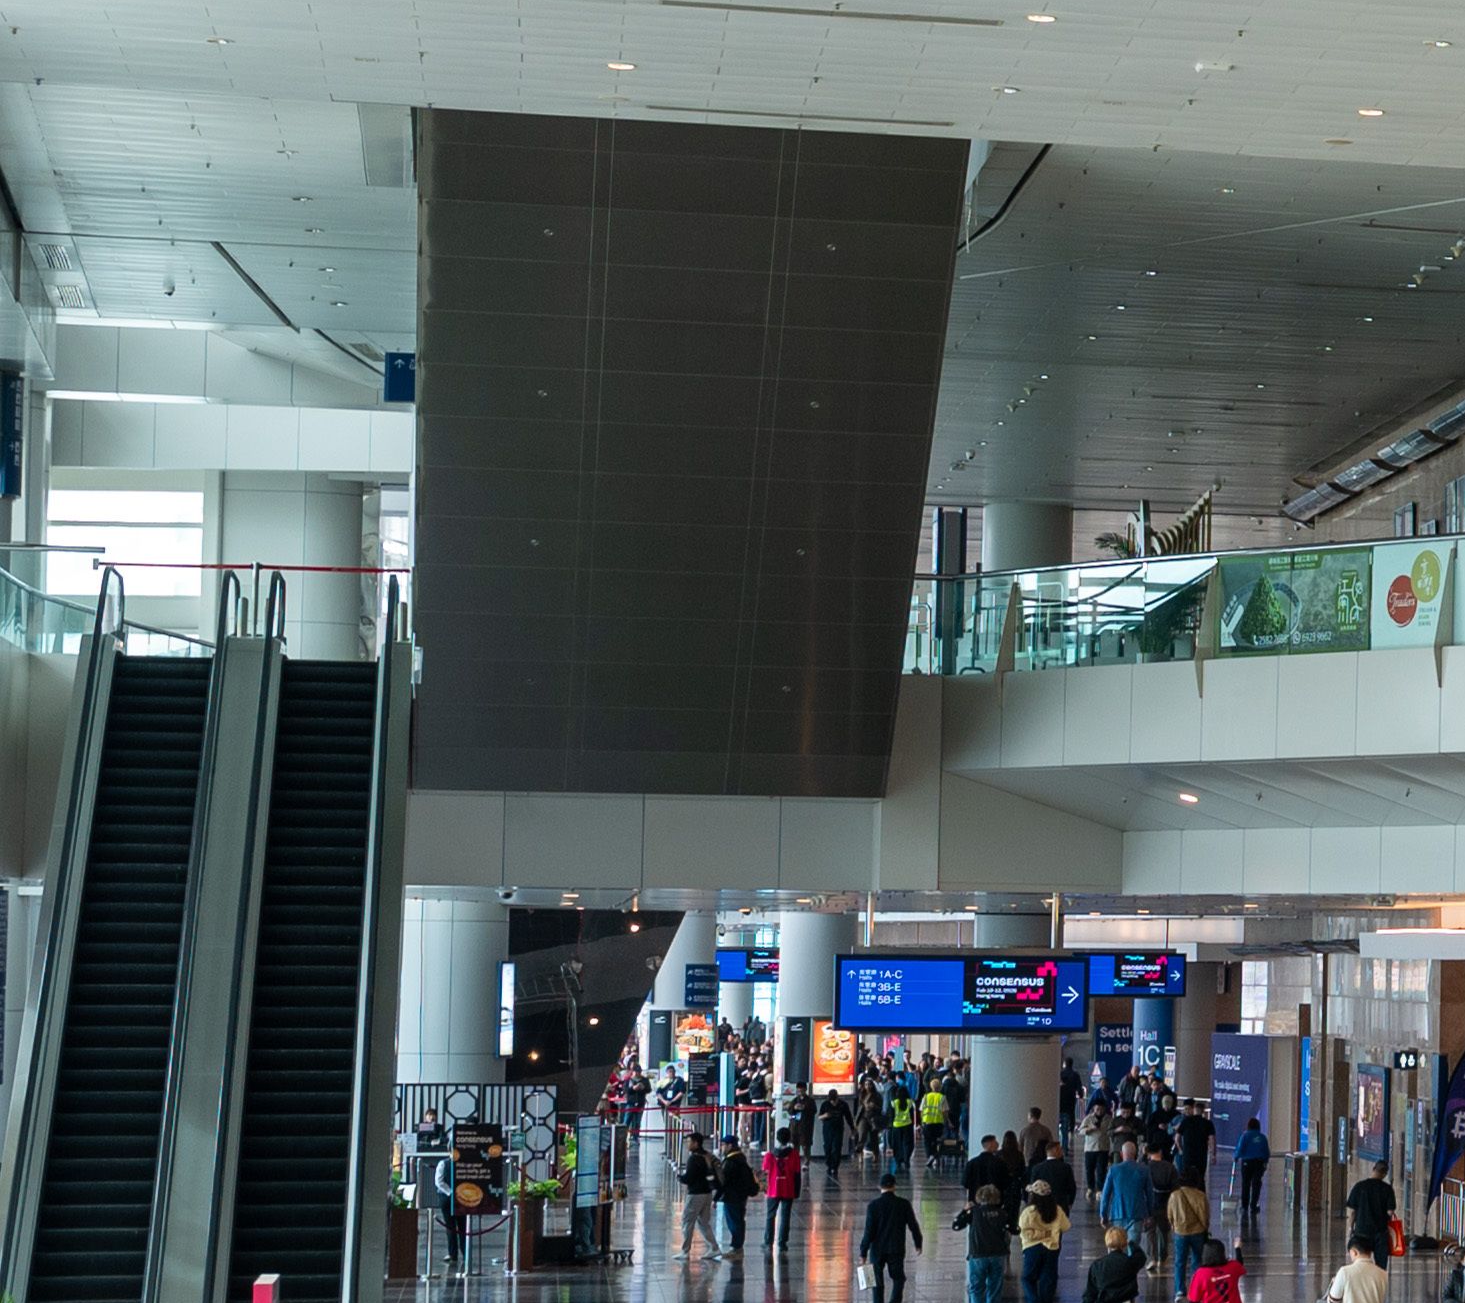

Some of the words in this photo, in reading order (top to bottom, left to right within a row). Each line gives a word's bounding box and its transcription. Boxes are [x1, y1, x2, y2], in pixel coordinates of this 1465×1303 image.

[976, 977, 1045, 986] CONSENSUS
[1140, 1031, 1158, 1041] Hall
[1100, 1041, 1112, 1052] in
[1138, 1045, 1160, 1066] 1C
